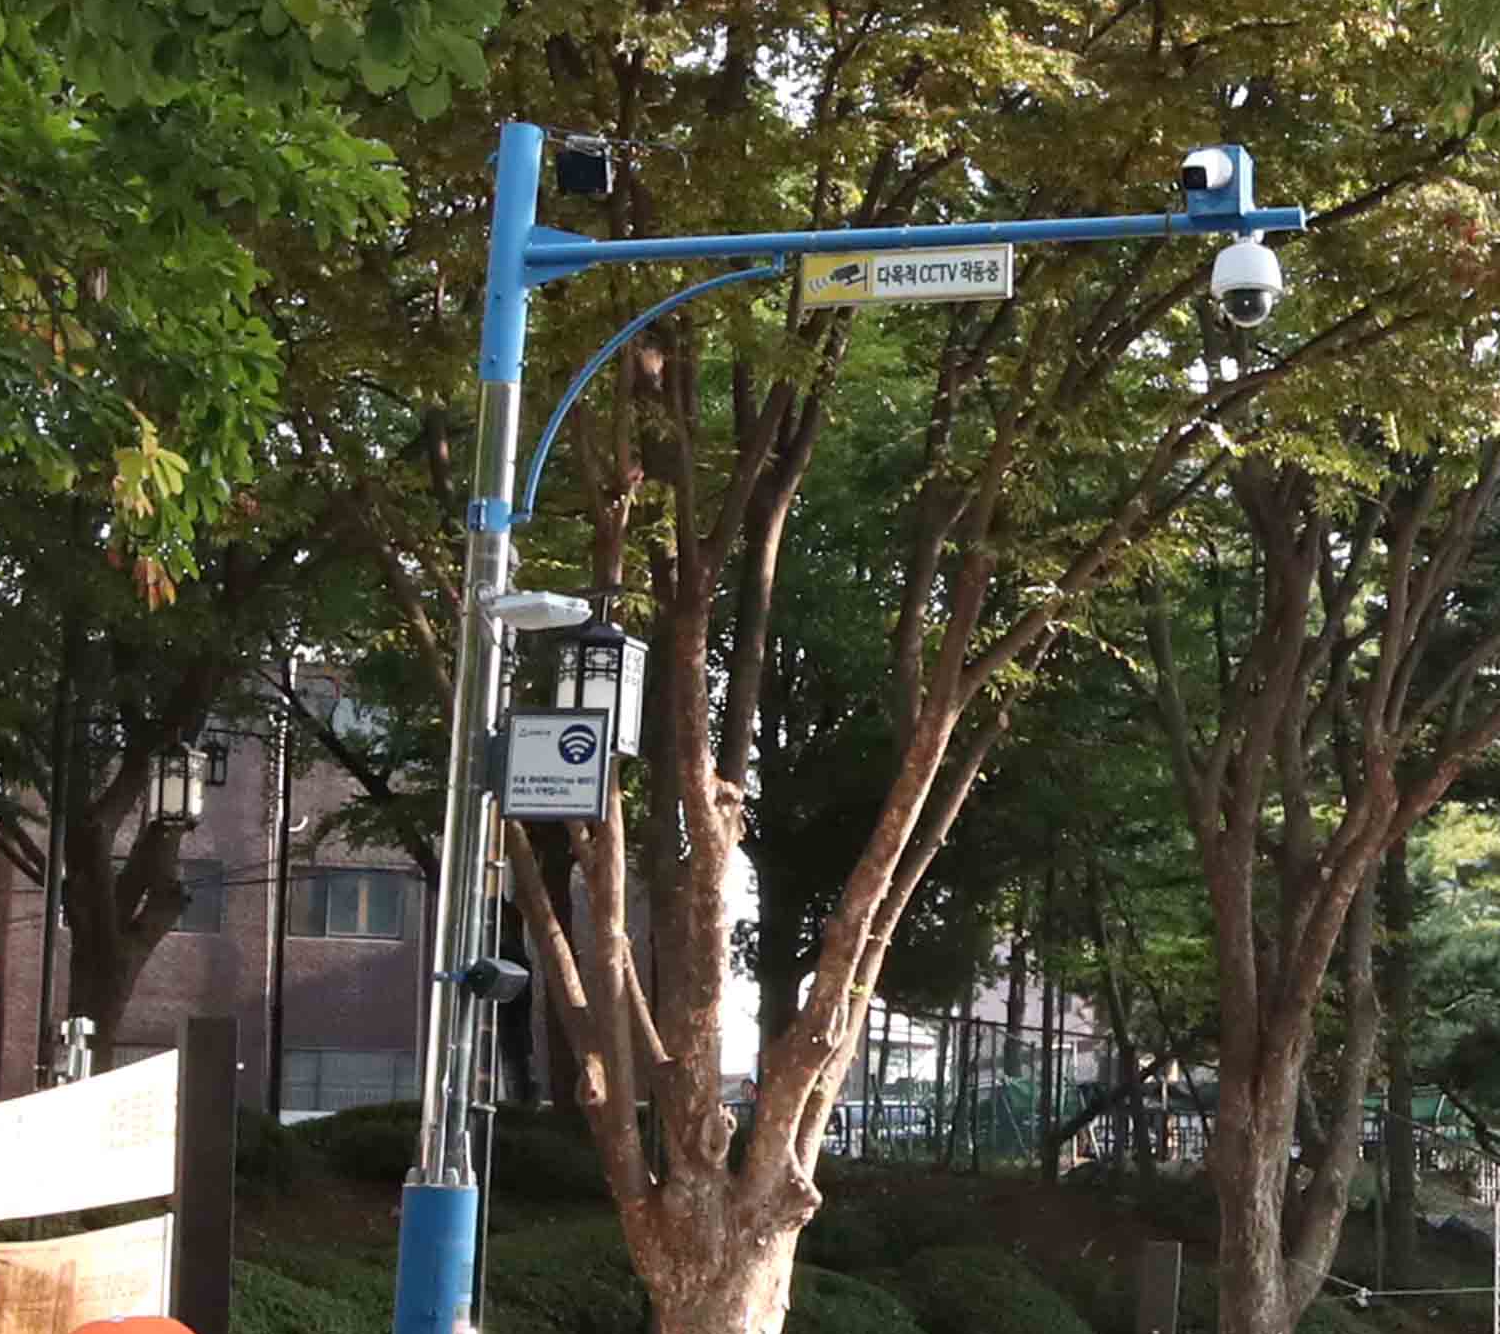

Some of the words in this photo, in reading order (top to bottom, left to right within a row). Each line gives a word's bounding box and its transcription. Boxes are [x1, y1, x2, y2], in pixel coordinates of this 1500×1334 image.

[876, 264, 917, 287] 다목적
[919, 261, 958, 285] CCTV
[960, 259, 999, 284] 작동중
